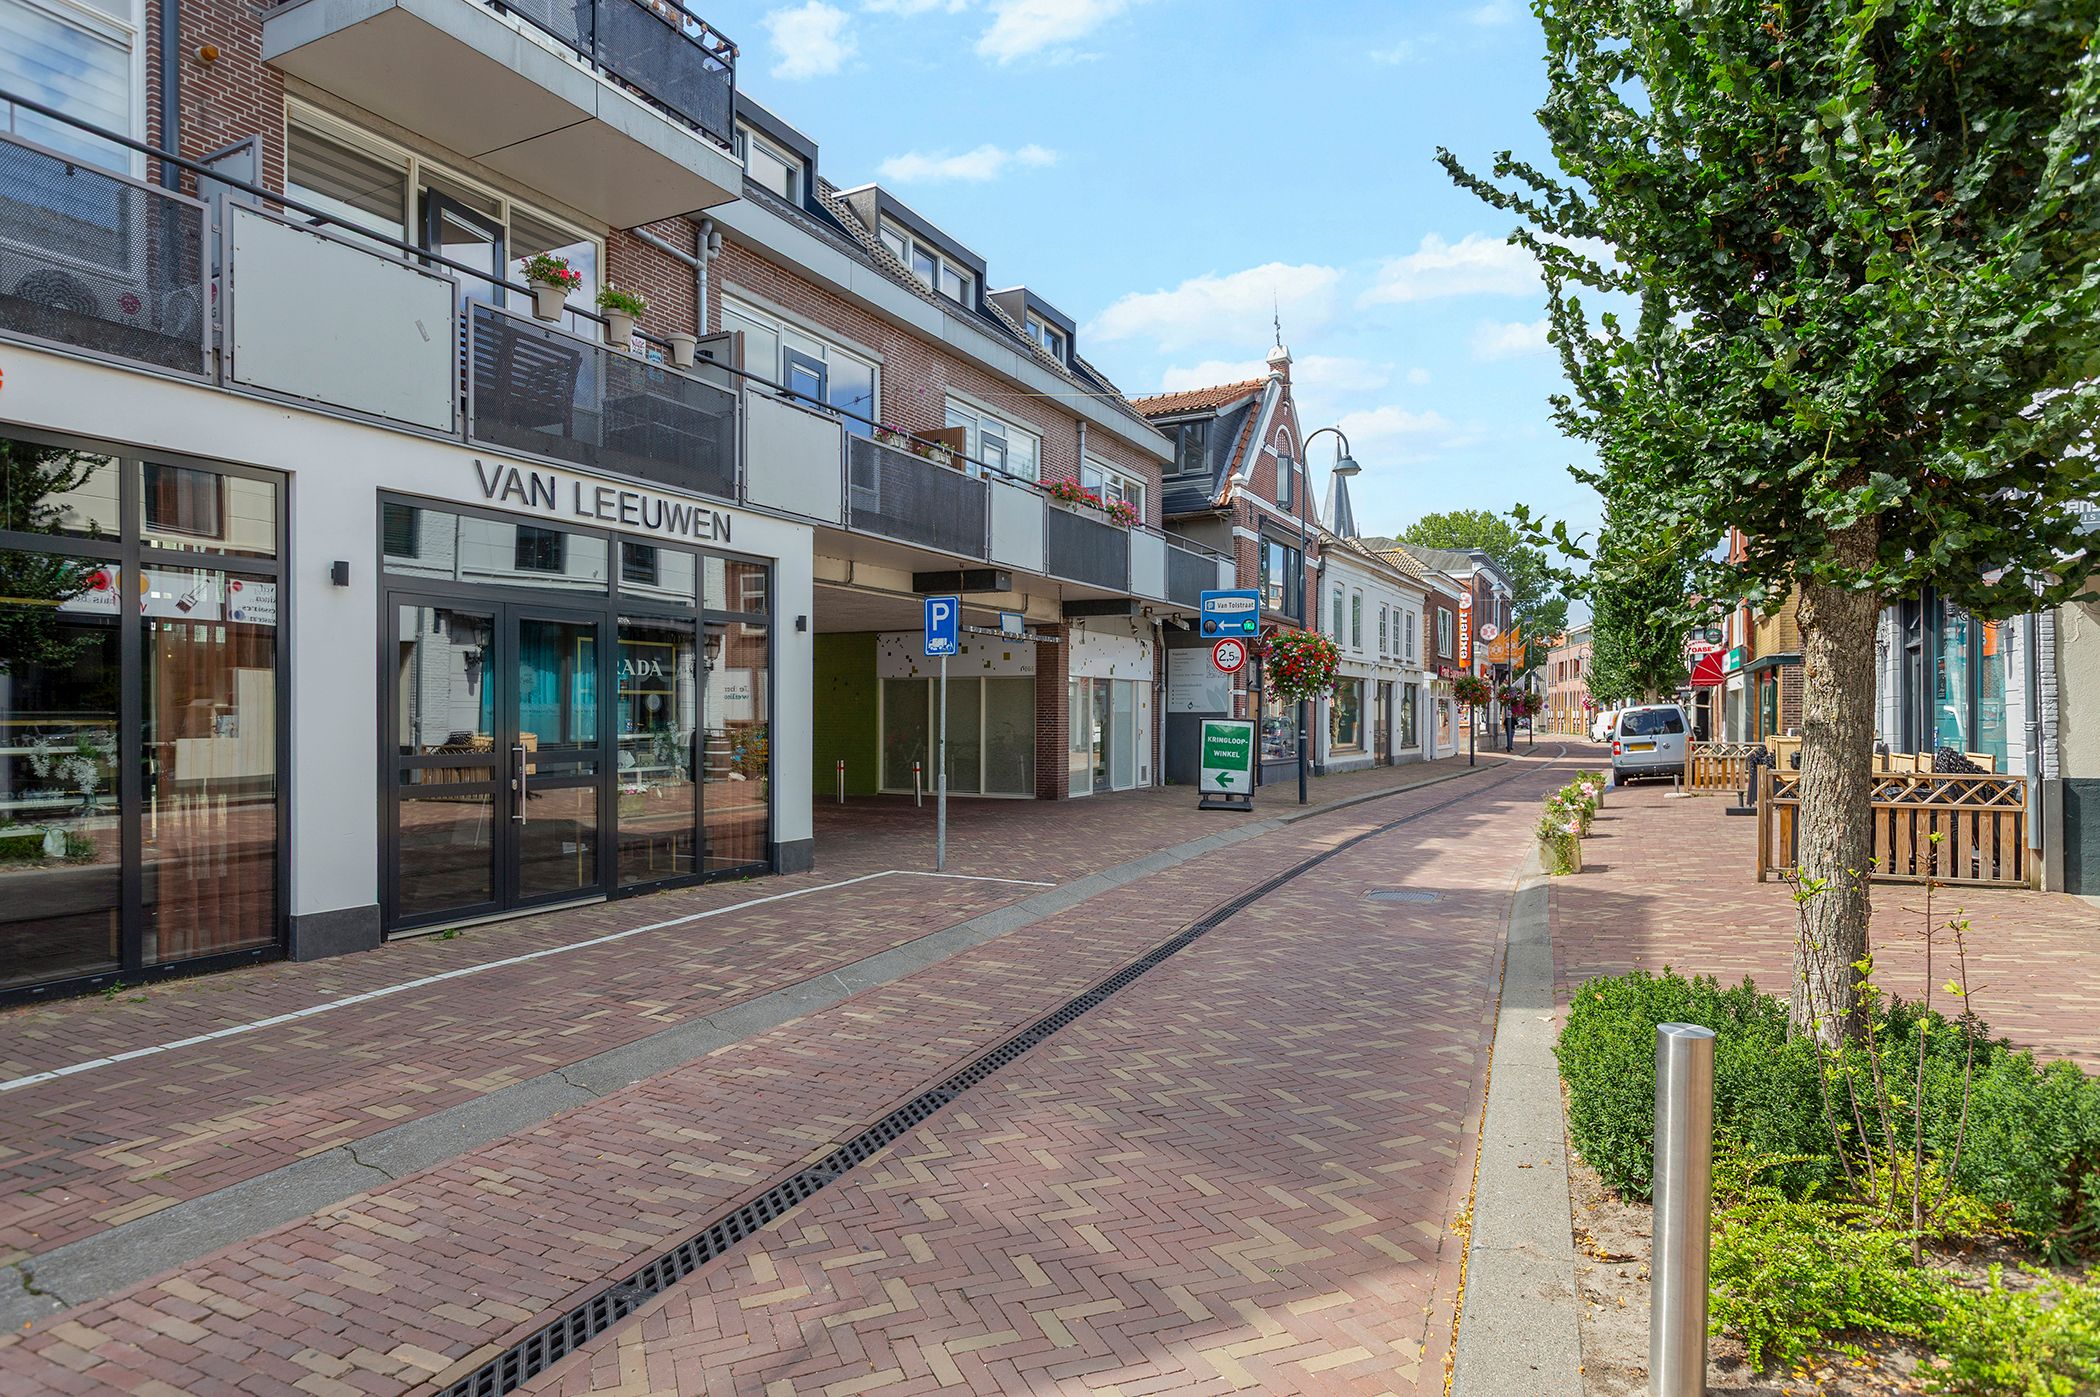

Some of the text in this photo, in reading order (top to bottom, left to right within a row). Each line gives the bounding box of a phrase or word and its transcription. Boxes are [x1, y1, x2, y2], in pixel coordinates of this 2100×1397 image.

[474, 459, 731, 543] VAN LEEUWEN
[932, 602, 950, 631] P
[1460, 612, 1469, 659] expert
[1207, 736, 1248, 745] KRINGLOOP-
[1213, 750, 1240, 759] WINKEL
